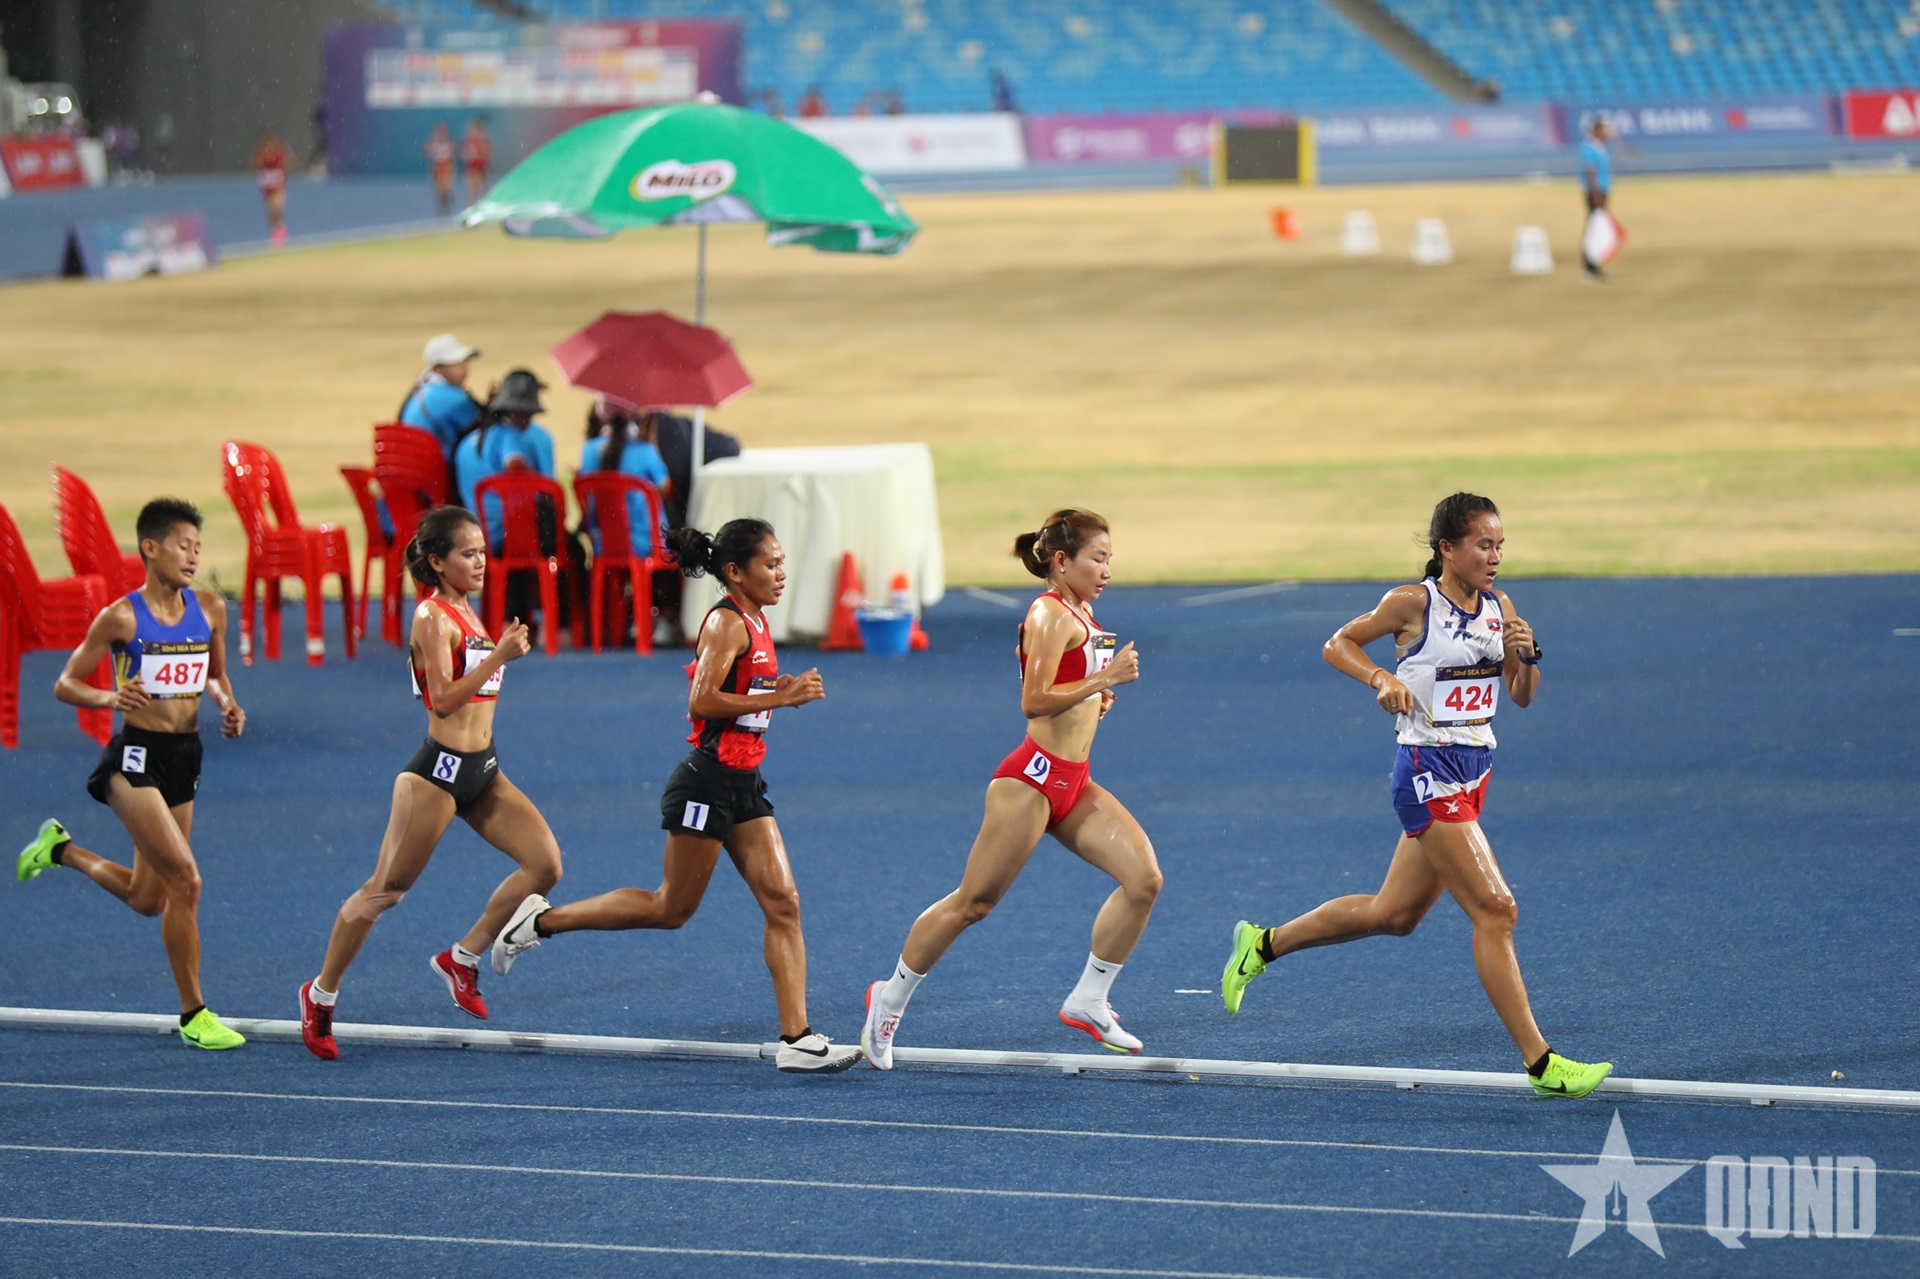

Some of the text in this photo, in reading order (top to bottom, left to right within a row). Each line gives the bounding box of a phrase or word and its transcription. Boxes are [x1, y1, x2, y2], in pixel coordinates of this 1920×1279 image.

[647, 173, 722, 189] MILO
[154, 662, 204, 686] 487
[1445, 683, 1493, 712] 424
[127, 748, 142, 772] 5
[437, 755, 456, 779] 8
[1027, 756, 1048, 777] 9
[1417, 775, 1433, 801] 2
[691, 805, 702, 828] 1
